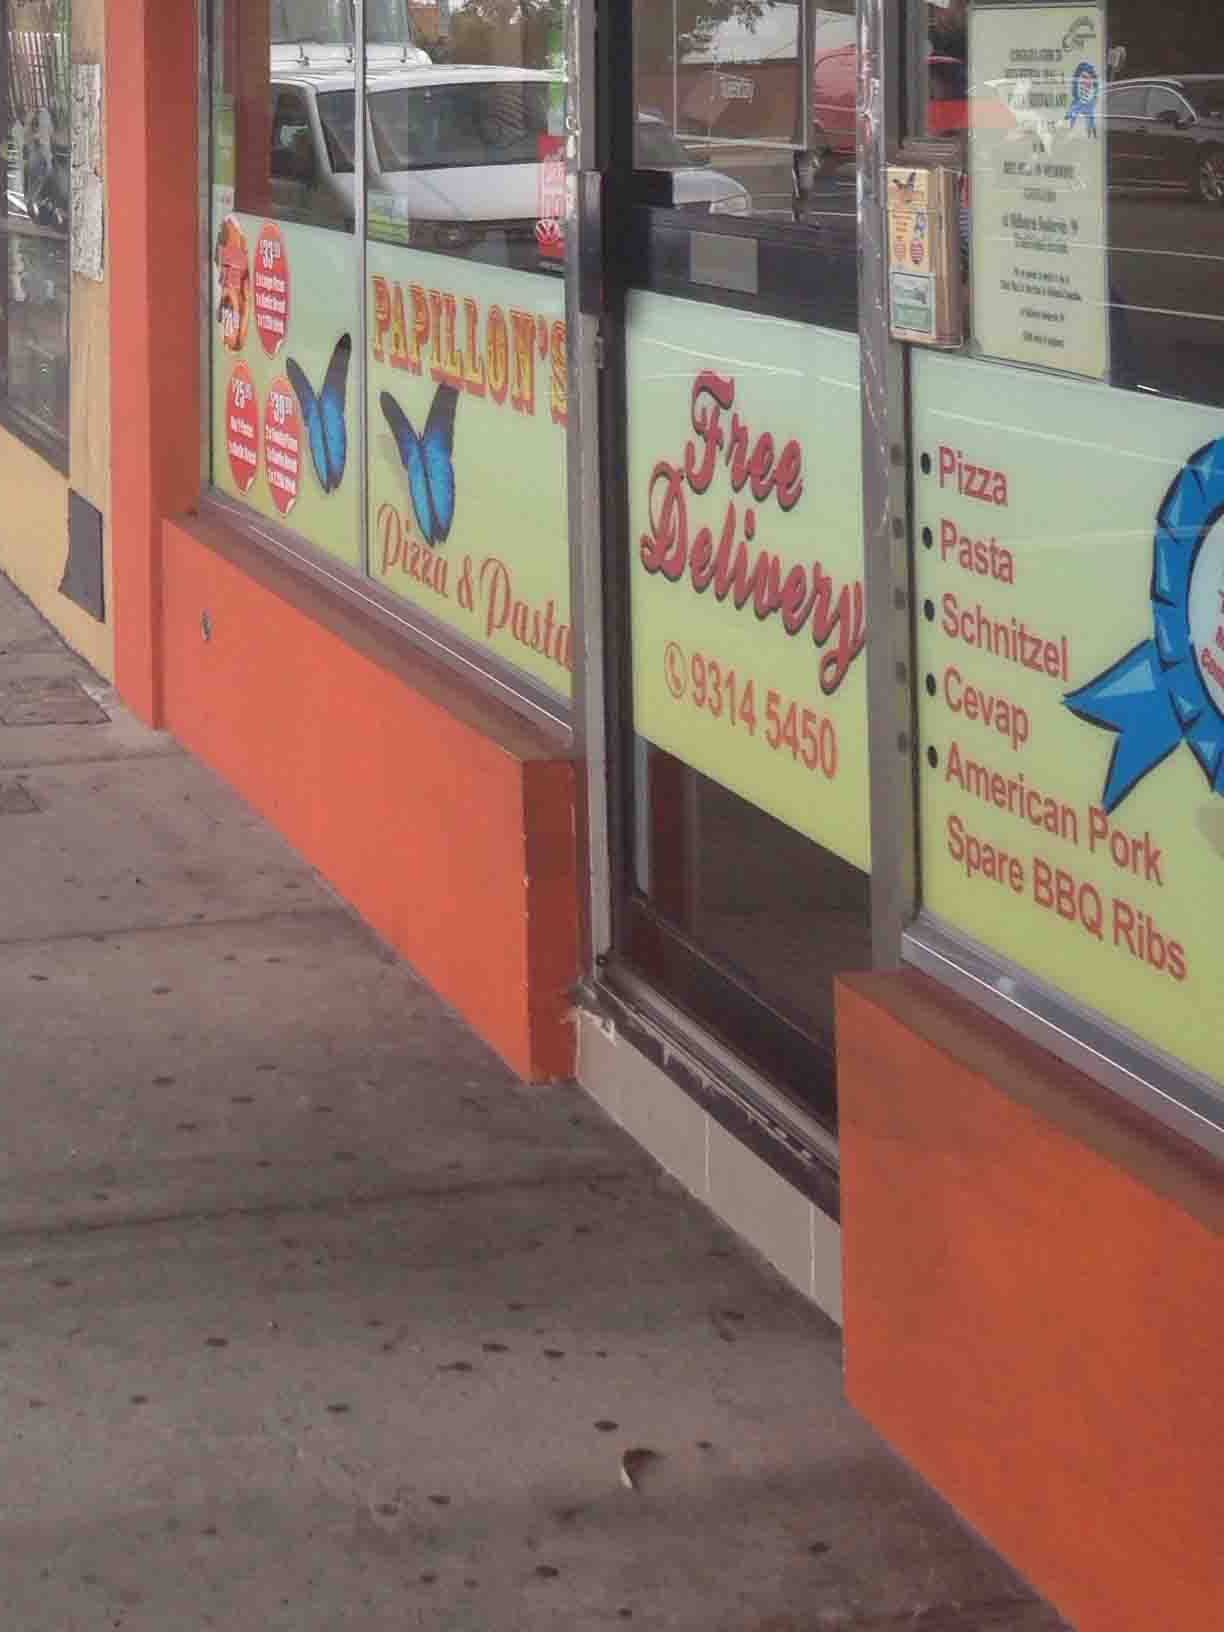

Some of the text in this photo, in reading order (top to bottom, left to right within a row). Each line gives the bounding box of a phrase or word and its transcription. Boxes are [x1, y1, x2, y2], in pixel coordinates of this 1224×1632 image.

[371, 274, 569, 427] PAPILLON'S
[684, 368, 803, 512] Free
[938, 446, 1009, 507] Pizza
[377, 503, 575, 673] Pizza & Pasta
[639, 461, 866, 695] Delivery
[940, 518, 1015, 584] Pasta
[942, 592, 1069, 682] Schnitzel
[944, 666, 1030, 751] Cevap
[691, 652, 839, 781] 9314 5450
[946, 741, 1164, 887] American Pork
[947, 815, 1188, 980] Spare BBQ Ribs
